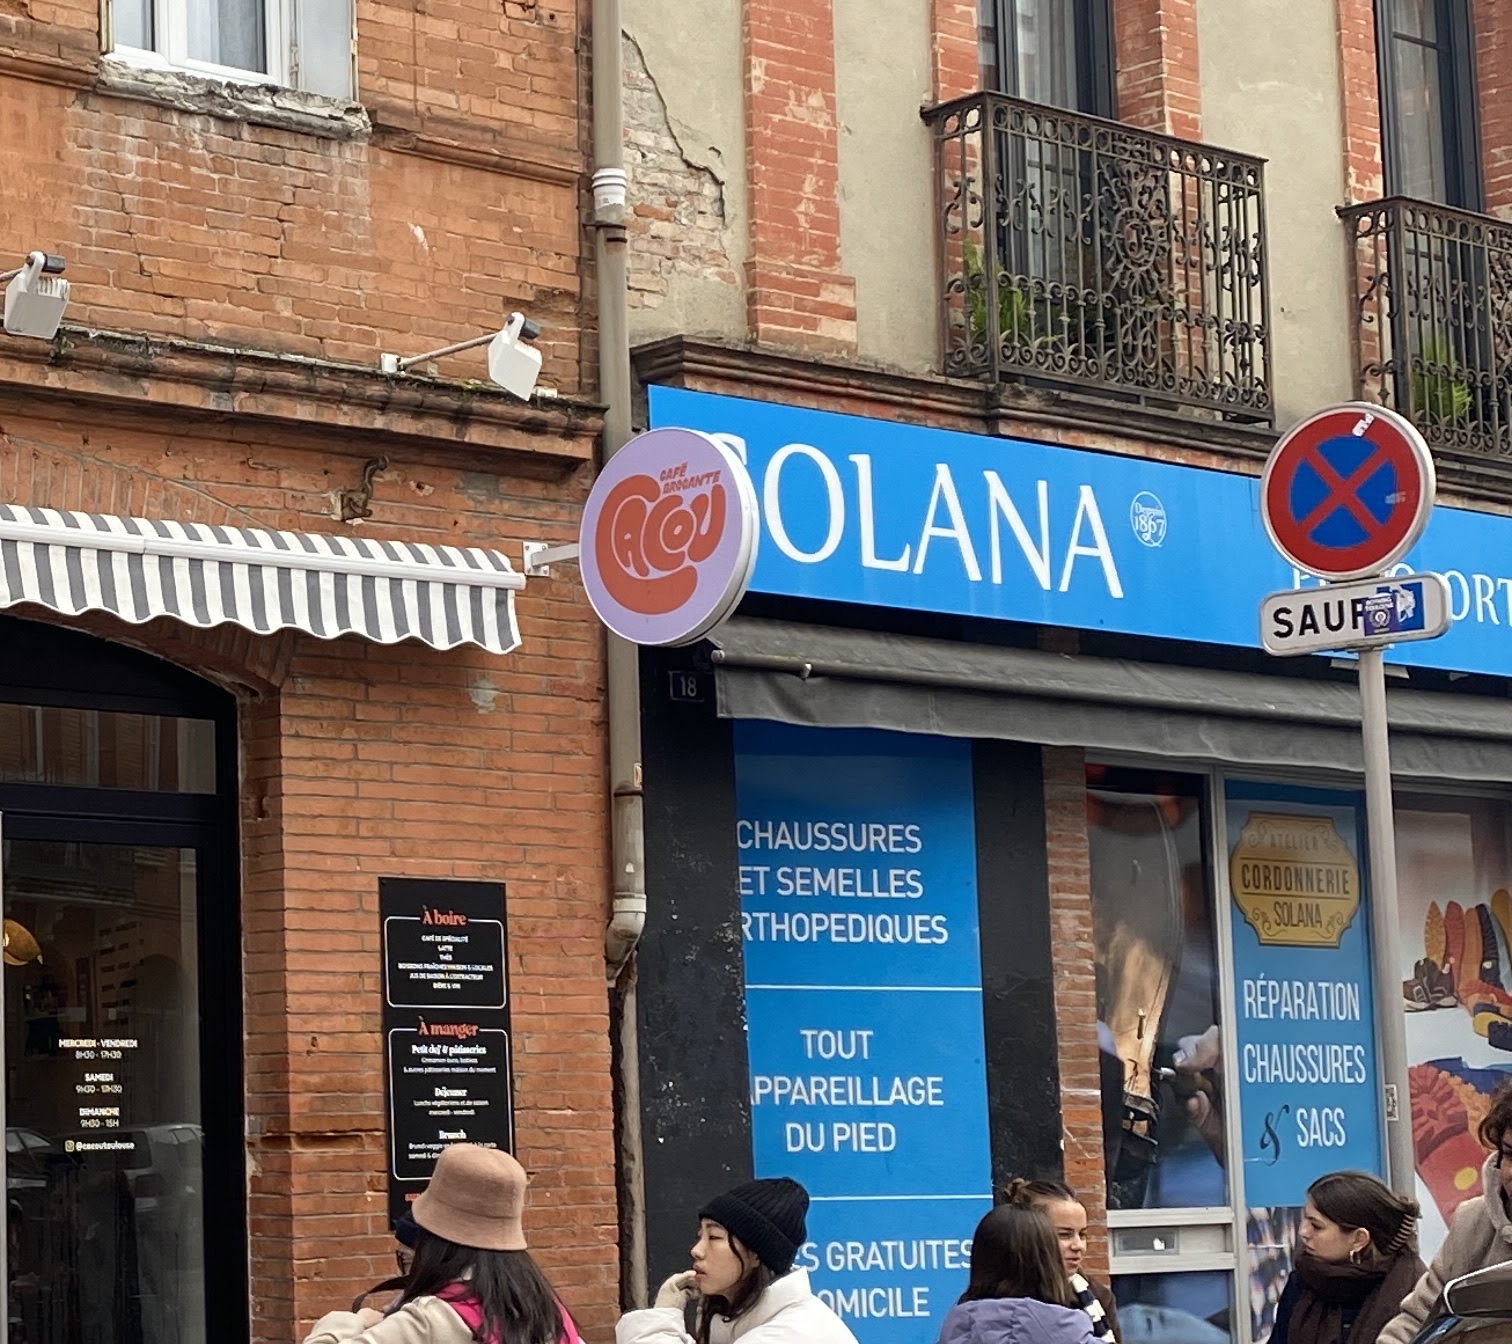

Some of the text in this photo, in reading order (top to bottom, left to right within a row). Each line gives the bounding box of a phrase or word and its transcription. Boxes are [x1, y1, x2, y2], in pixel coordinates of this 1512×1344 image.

[662, 469, 722, 495] BROCANTE
[1134, 514, 1165, 542] 1867
[594, 473, 726, 616] CACOU
[1272, 597, 1365, 639] SAUF
[679, 675, 697, 697] 18
[736, 819, 923, 854] CHAUSSURES
[1270, 832, 1320, 852] ATELIER
[737, 865, 924, 899] ET SEMELLES
[1240, 863, 1351, 896] CORDONNERIE
[433, 908, 467, 926] boire
[740, 912, 949, 945] RTHOPEDIQUES
[1273, 900, 1323, 929] SOLANA
[1243, 972, 1361, 1022] RÉPARATION
[58, 1039, 97, 1048] MERCREDI
[100, 1039, 138, 1048] VENDREDI
[431, 1022, 479, 1040] manger
[799, 1029, 874, 1060] TOUT
[84, 1073, 114, 1082] SAMEDI
[1243, 1043, 1367, 1084] CHAUSSURES
[748, 1076, 945, 1106] PPAREILLAGE
[79, 1107, 120, 1116] DIMANCHE
[786, 1122, 897, 1153] DU PIED
[1296, 1107, 1347, 1148] SACS
[826, 1239, 974, 1272] GRATUITES
[817, 1287, 931, 1319] OMICILE
